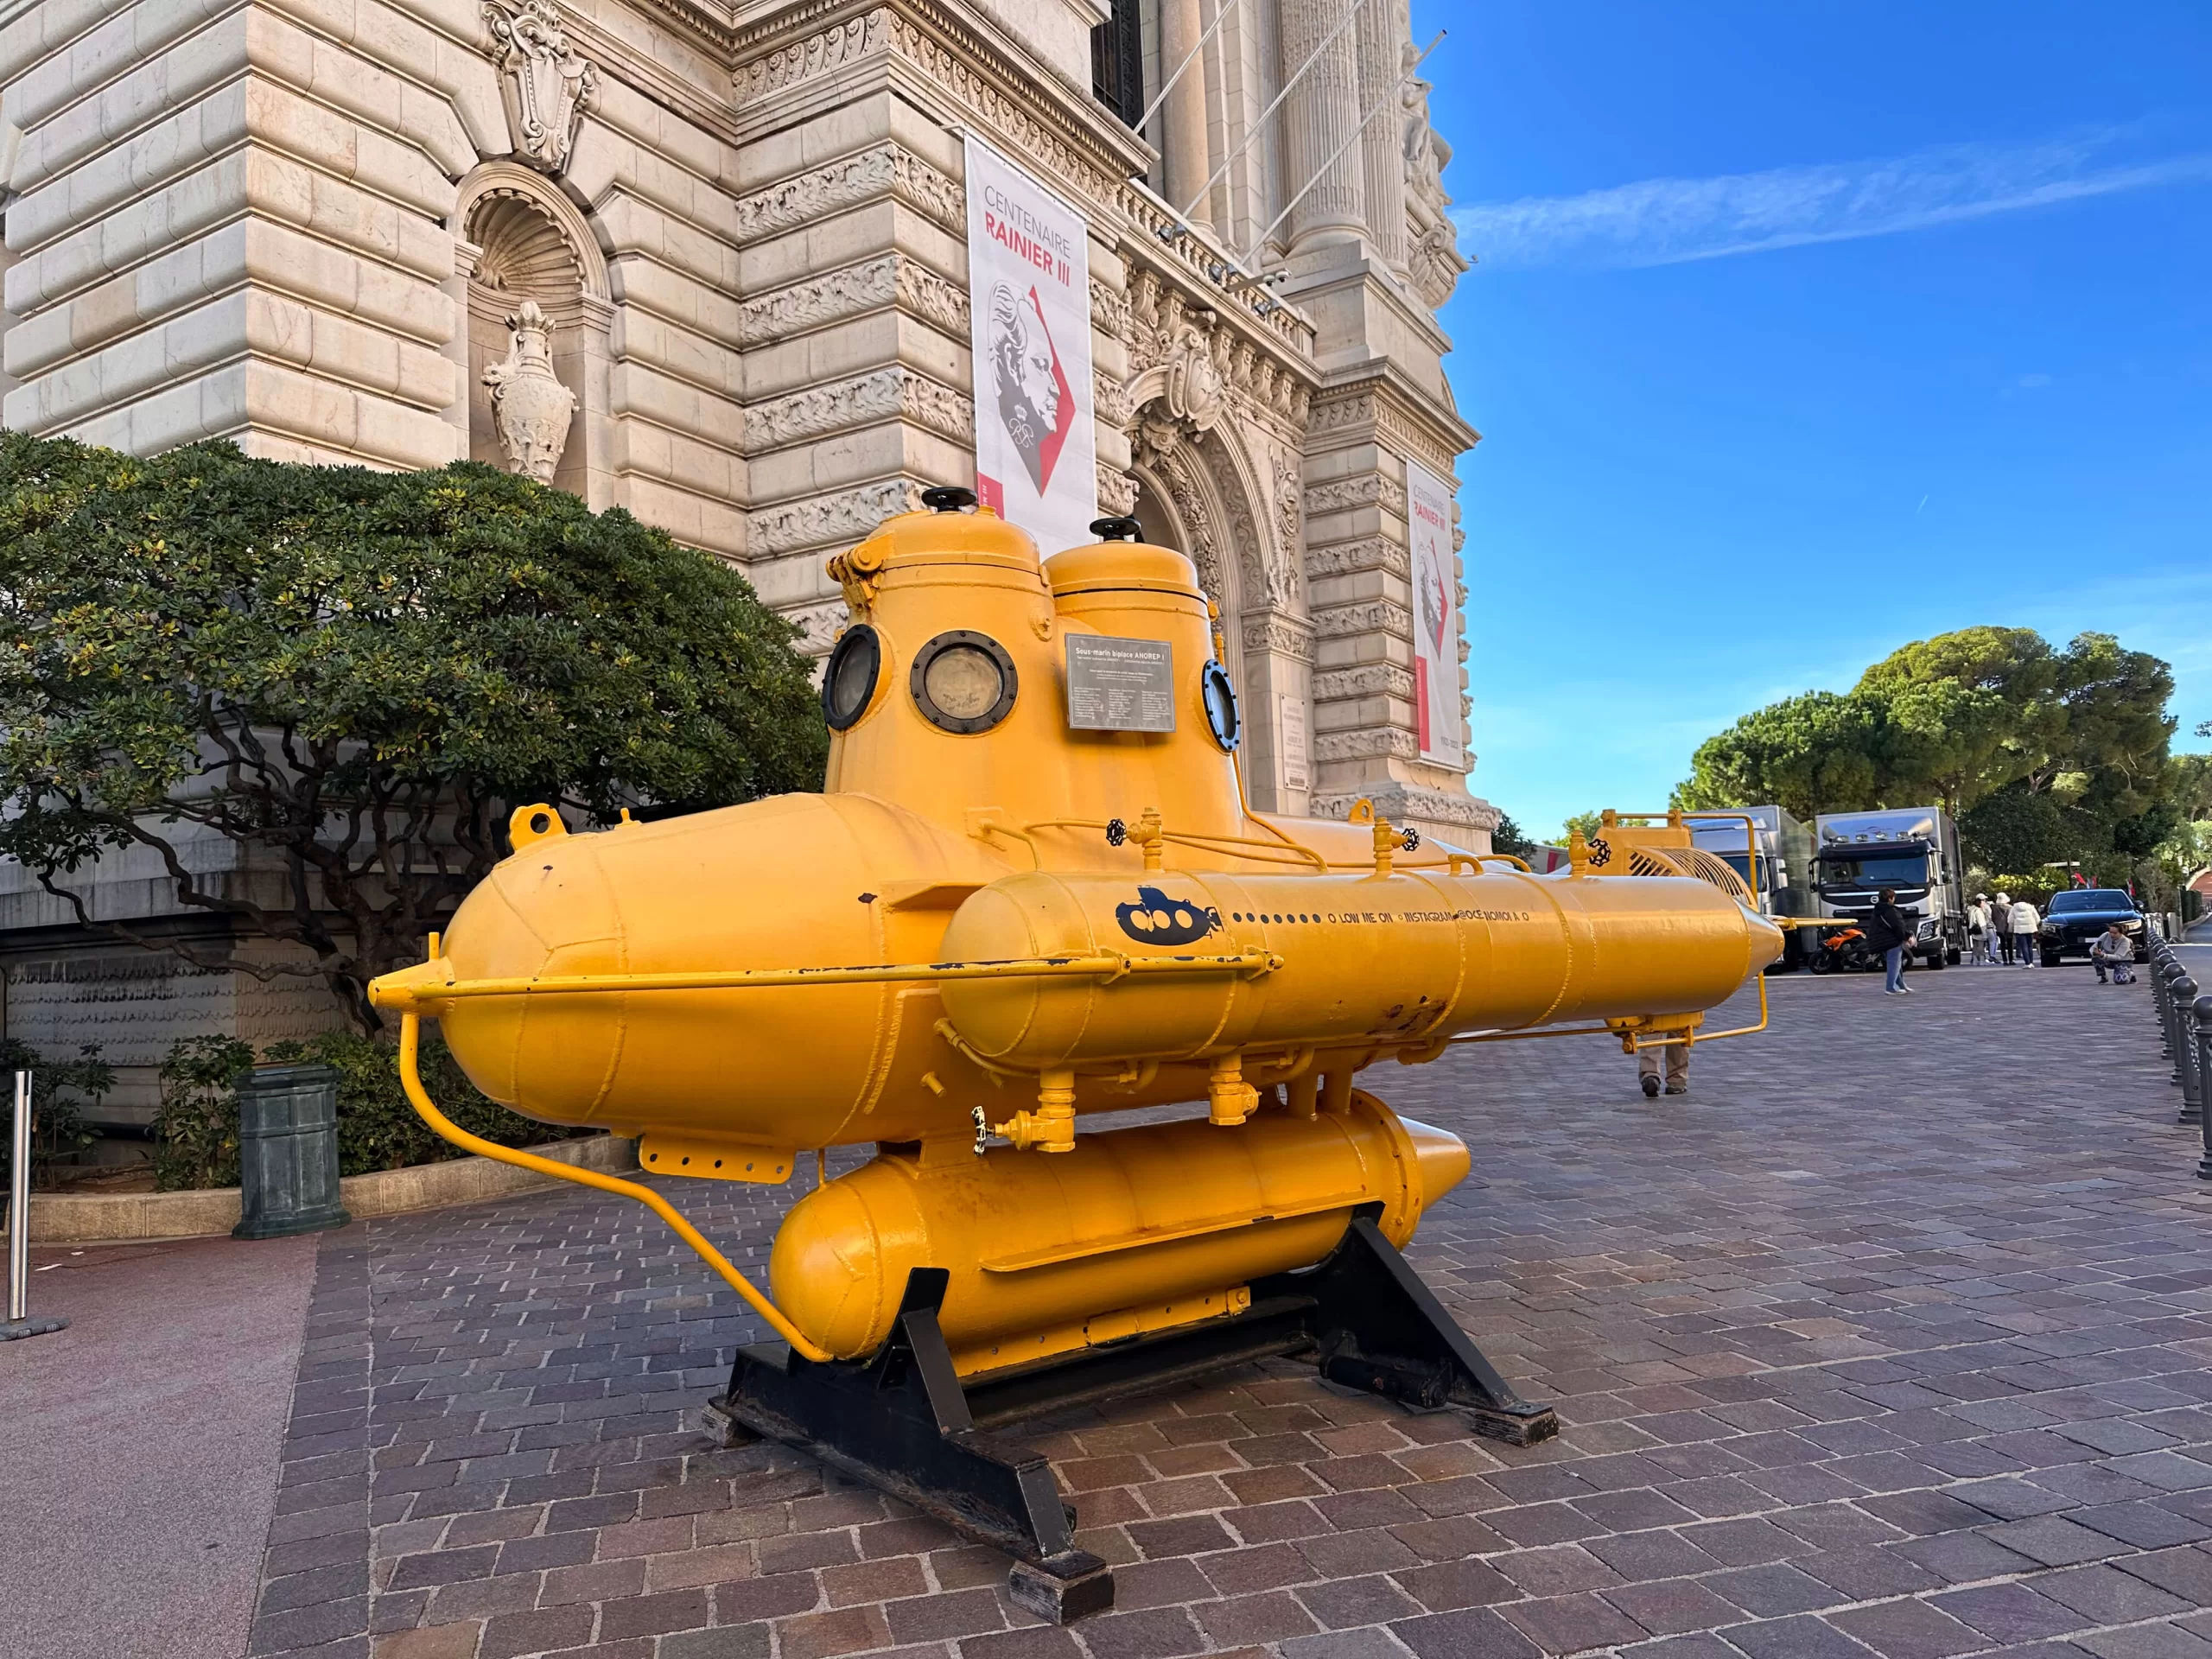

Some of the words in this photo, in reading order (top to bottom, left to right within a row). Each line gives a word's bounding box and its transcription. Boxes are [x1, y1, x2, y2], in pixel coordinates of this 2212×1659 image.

[985, 185, 1071, 259] CENTENAIRE
[985, 210, 1053, 276] RAINIER
[1058, 259, 1070, 287] III
[1076, 647, 1111, 657] Sous-marin
[1112, 650, 1134, 658] biplace
[1362, 912, 1377, 924] ME
[1378, 912, 1394, 924] ON
[1403, 911, 1453, 923] INSTAGRAM
